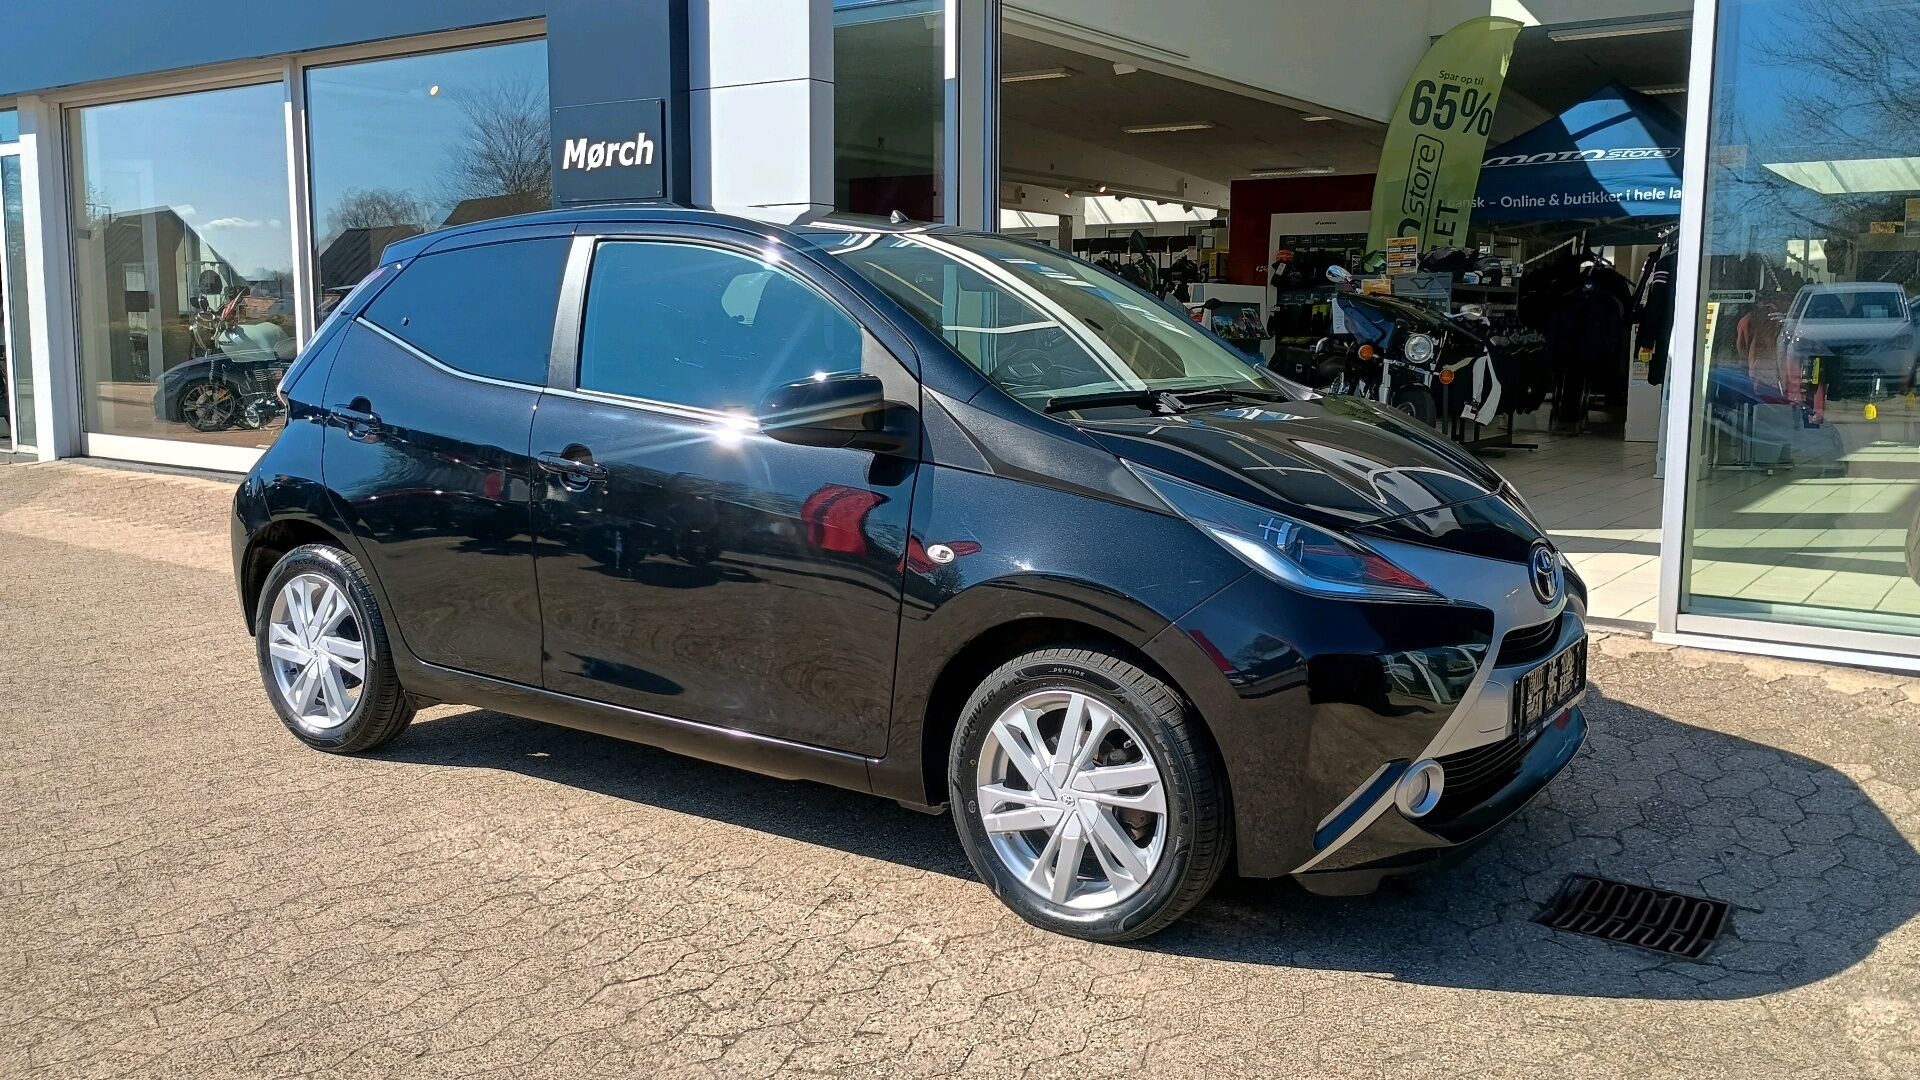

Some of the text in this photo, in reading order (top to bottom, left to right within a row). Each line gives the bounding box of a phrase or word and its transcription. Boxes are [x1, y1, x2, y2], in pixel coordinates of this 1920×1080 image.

[1438, 70, 1484, 86] Spar op til
[1408, 79, 1493, 137] 65%
[562, 132, 654, 171] Mørch
[1500, 194, 1544, 208] Online
[1548, 194, 1559, 206] &
[1564, 191, 1622, 206] butikker
[1625, 189, 1630, 202] i
[1634, 187, 1665, 202] hele
